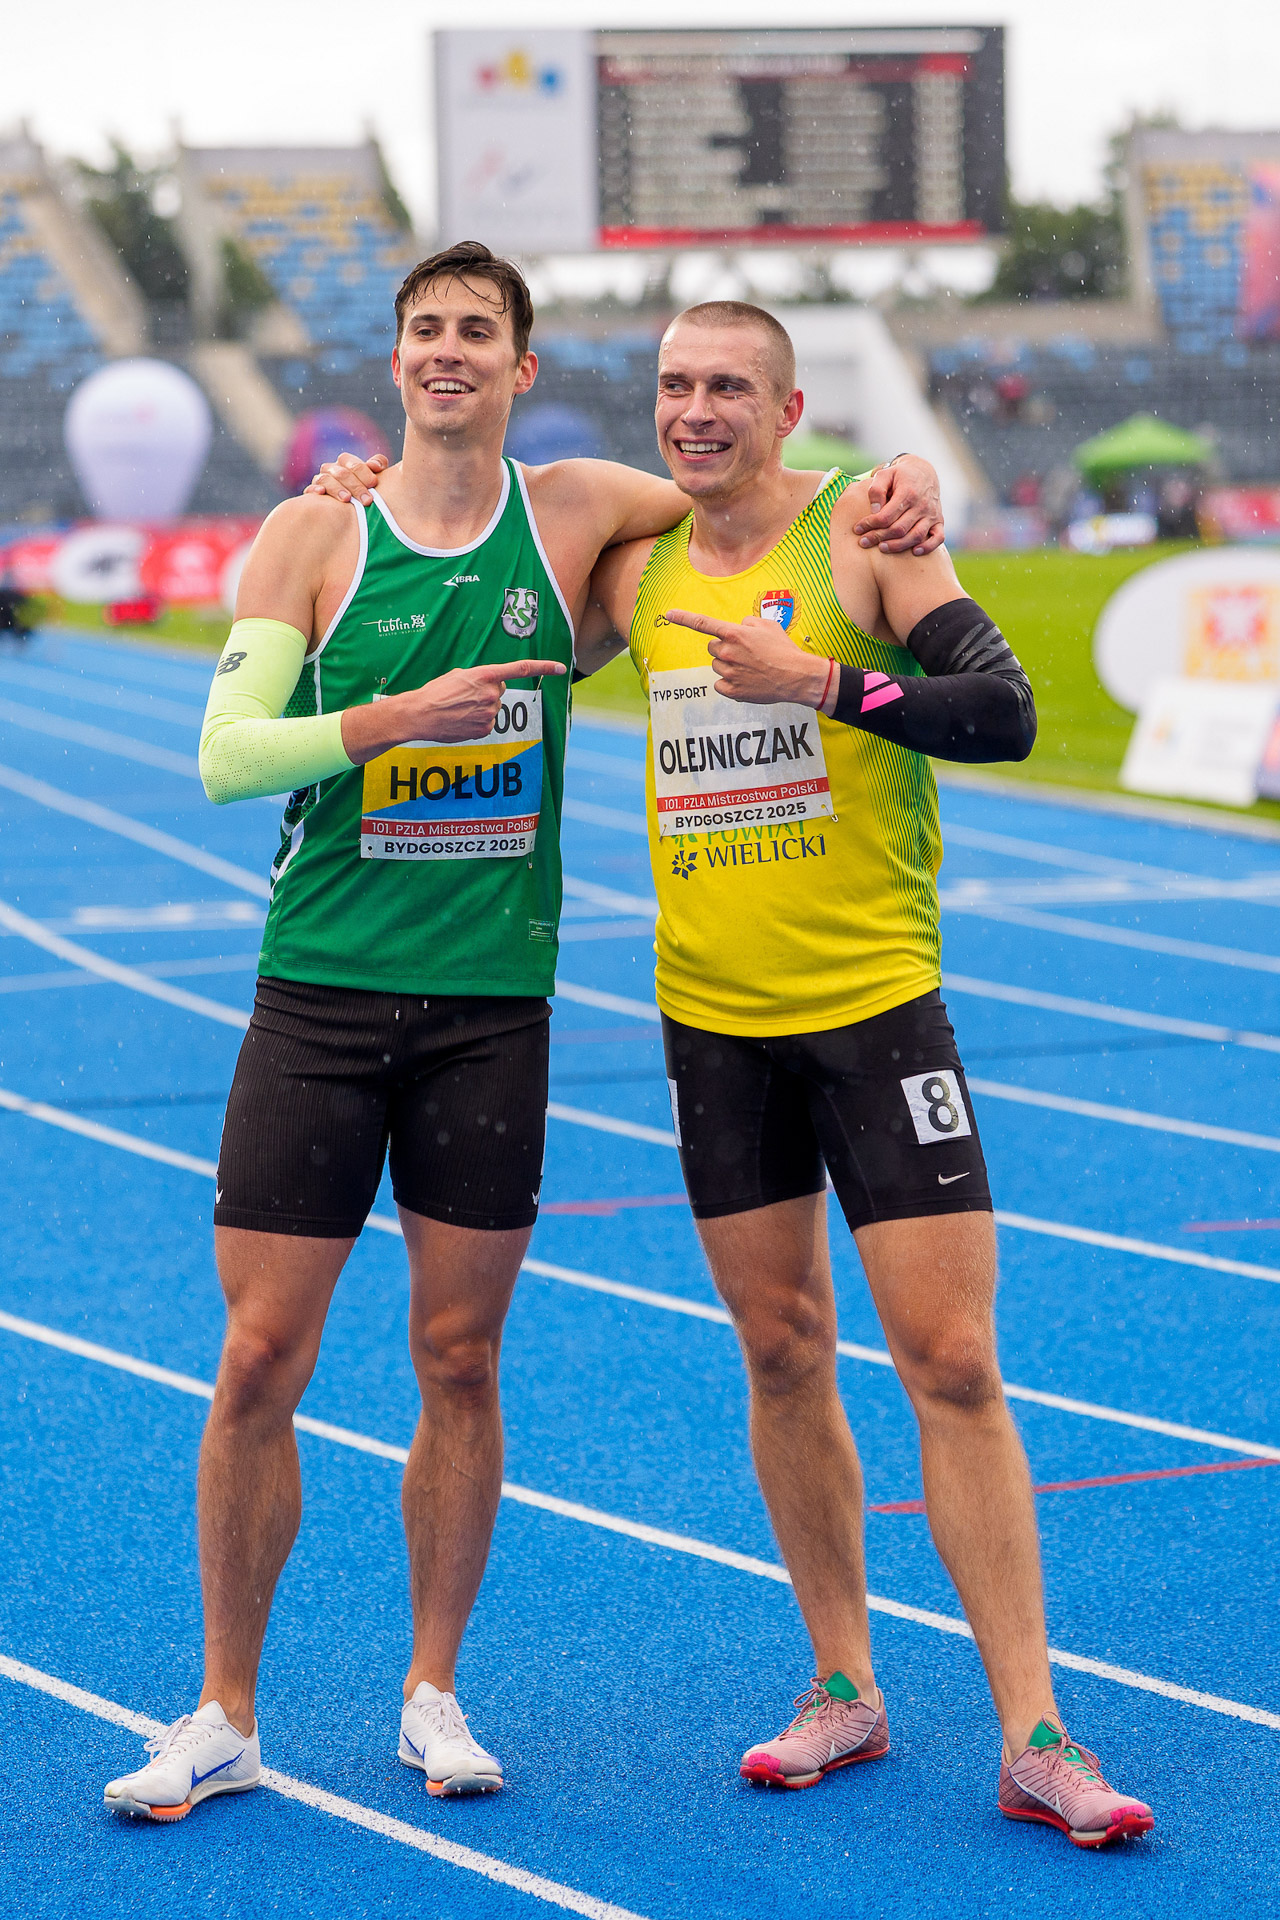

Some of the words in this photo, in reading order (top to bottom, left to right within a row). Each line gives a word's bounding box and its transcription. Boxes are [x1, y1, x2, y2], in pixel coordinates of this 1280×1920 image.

[653, 690, 672, 702] TVP
[674, 686, 708, 701] SPORT
[659, 722, 815, 775] OLEJNICZAK
[390, 762, 523, 801] HOŁUB
[665, 799, 682, 810] 101.
[684, 797, 707, 809] PZLA
[708, 789, 778, 806] Mistrzostwa
[780, 781, 819, 798] Polski
[372, 822, 392, 834] 101.
[395, 824, 426, 836] PZLA
[429, 823, 504, 835] Mistrzostwa
[507, 819, 535, 832] Polski
[675, 809, 764, 829] BYDGOSZCZ
[767, 802, 808, 818] 2025
[384, 841, 486, 854] BYDGOSZCZ
[489, 838, 527, 852] 2025
[703, 835, 827, 868] WIELICKI
[921, 1076, 960, 1133] 8
